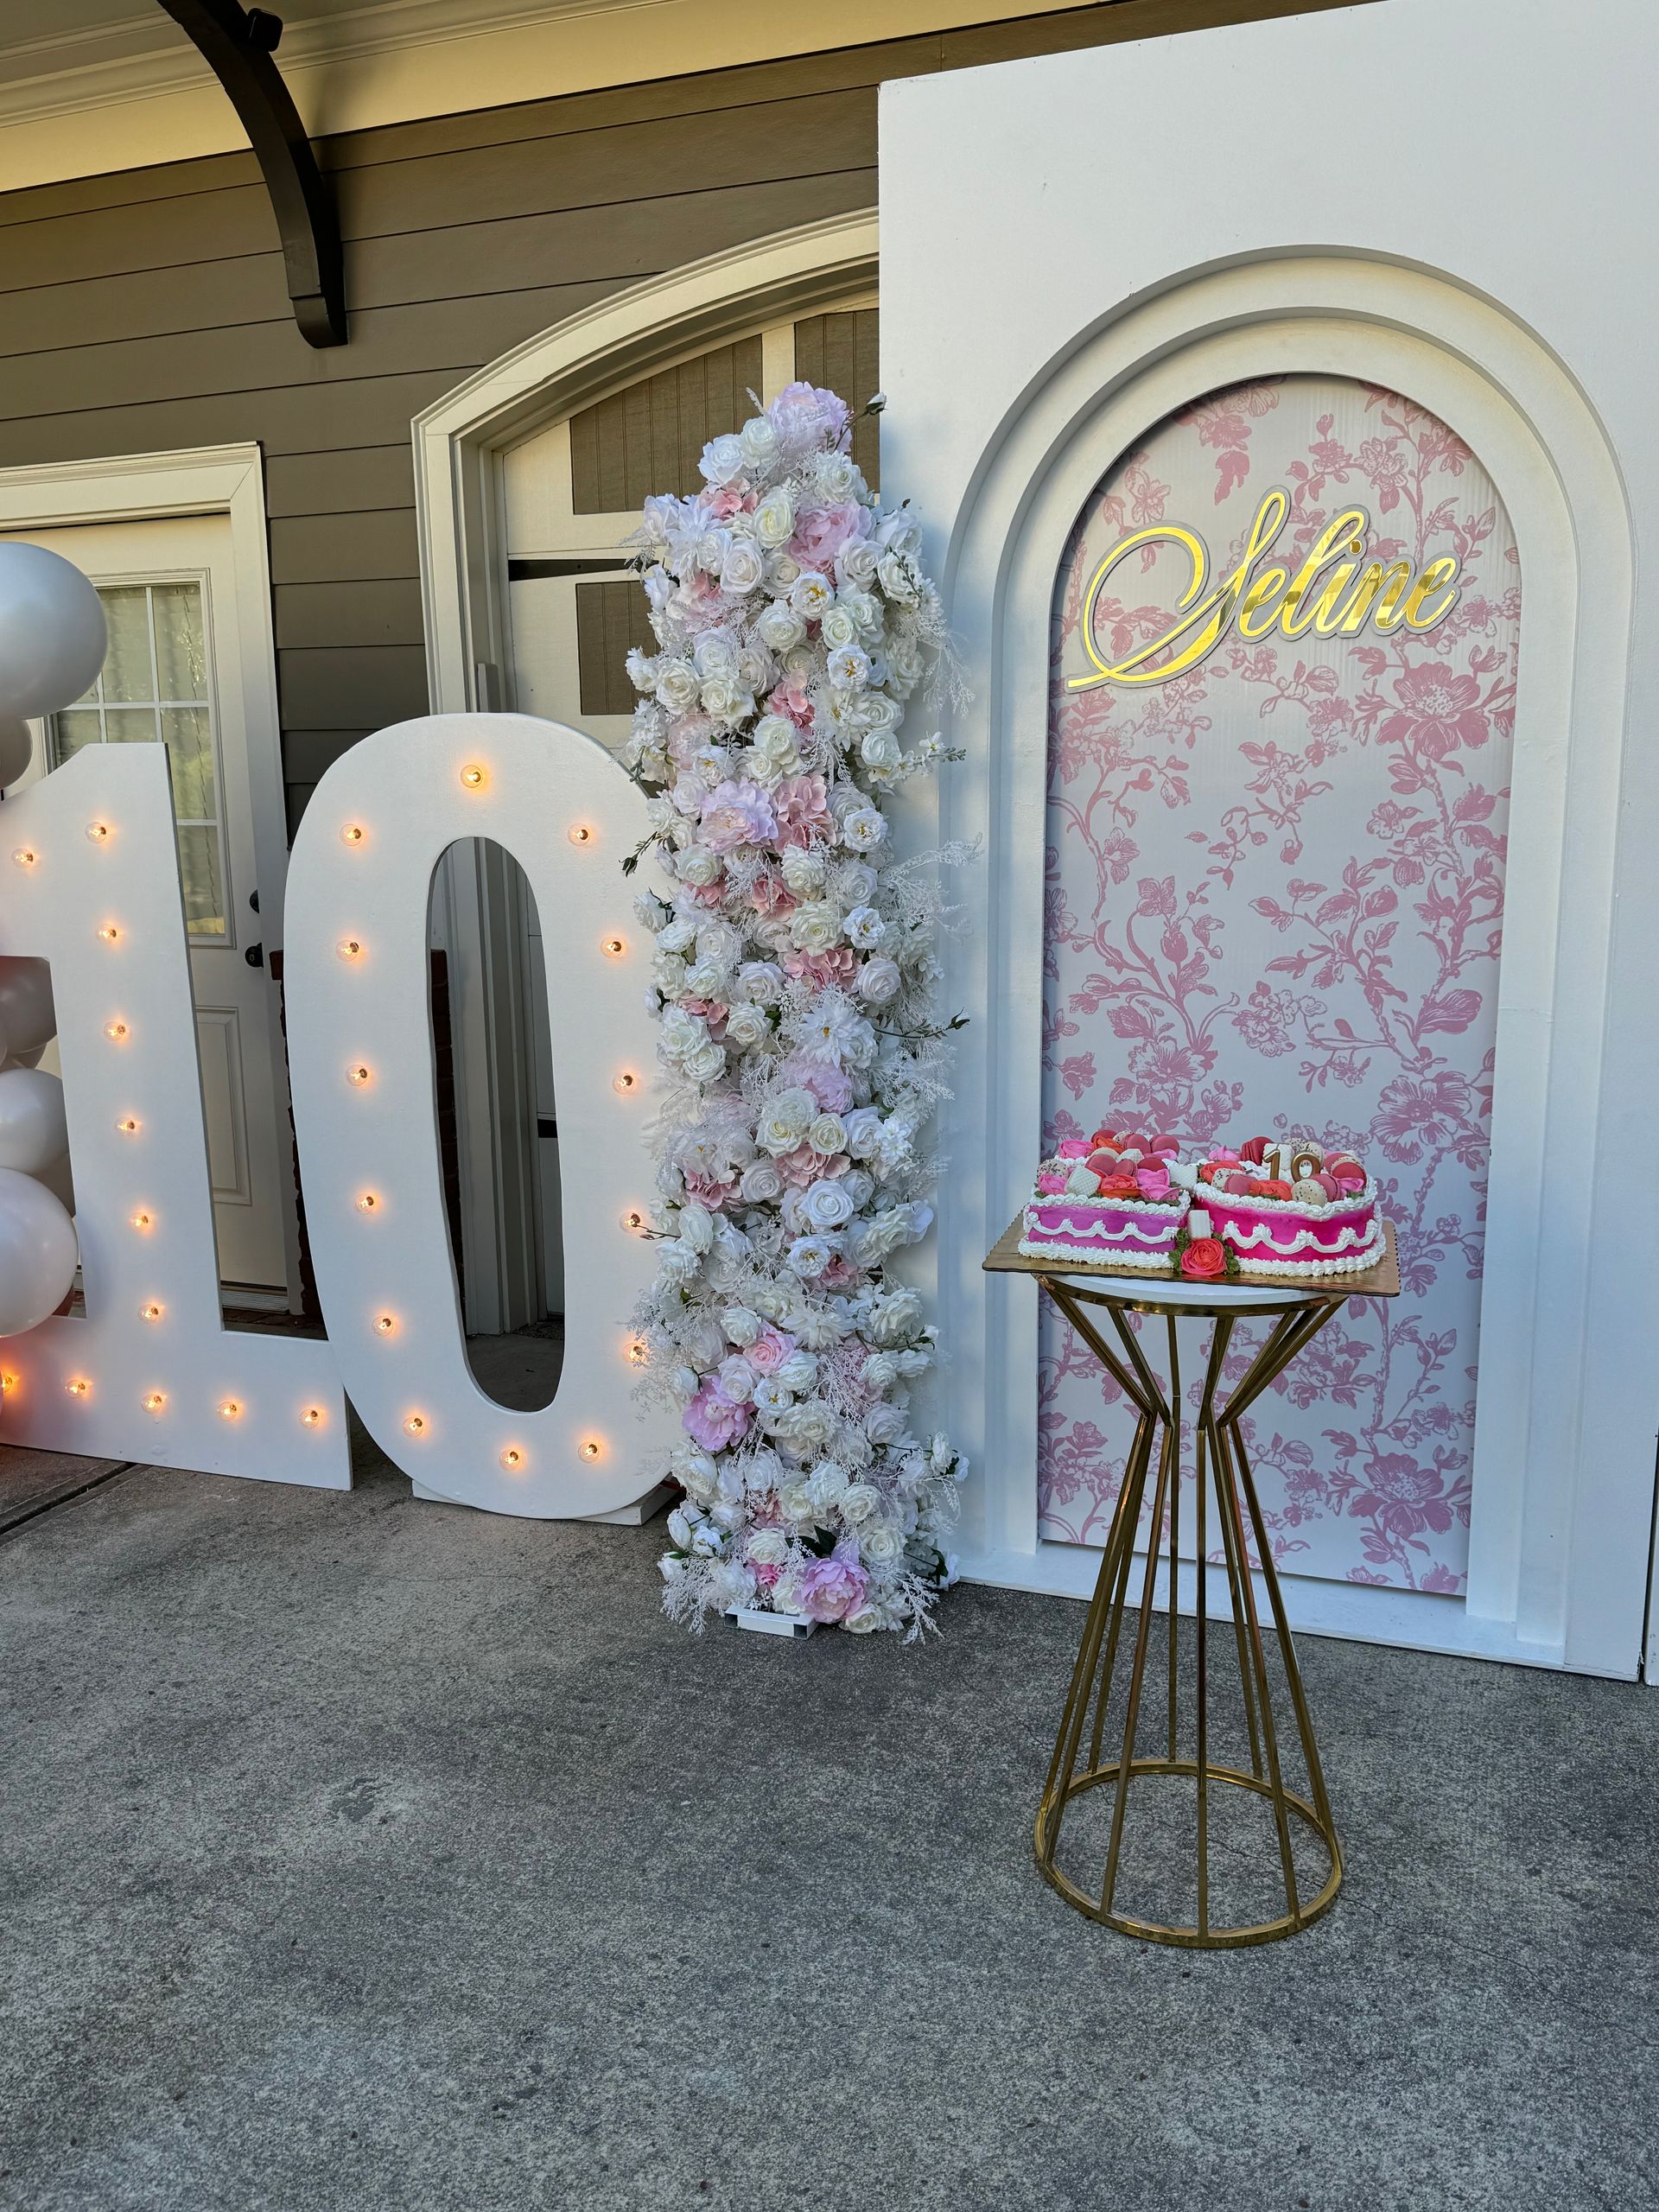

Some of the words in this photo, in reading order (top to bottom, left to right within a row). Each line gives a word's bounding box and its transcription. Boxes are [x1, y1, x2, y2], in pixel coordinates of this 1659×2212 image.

[1068, 491, 1458, 688] Seline
[0, 713, 678, 1519] 10
[1262, 1148, 1321, 1184] 10
